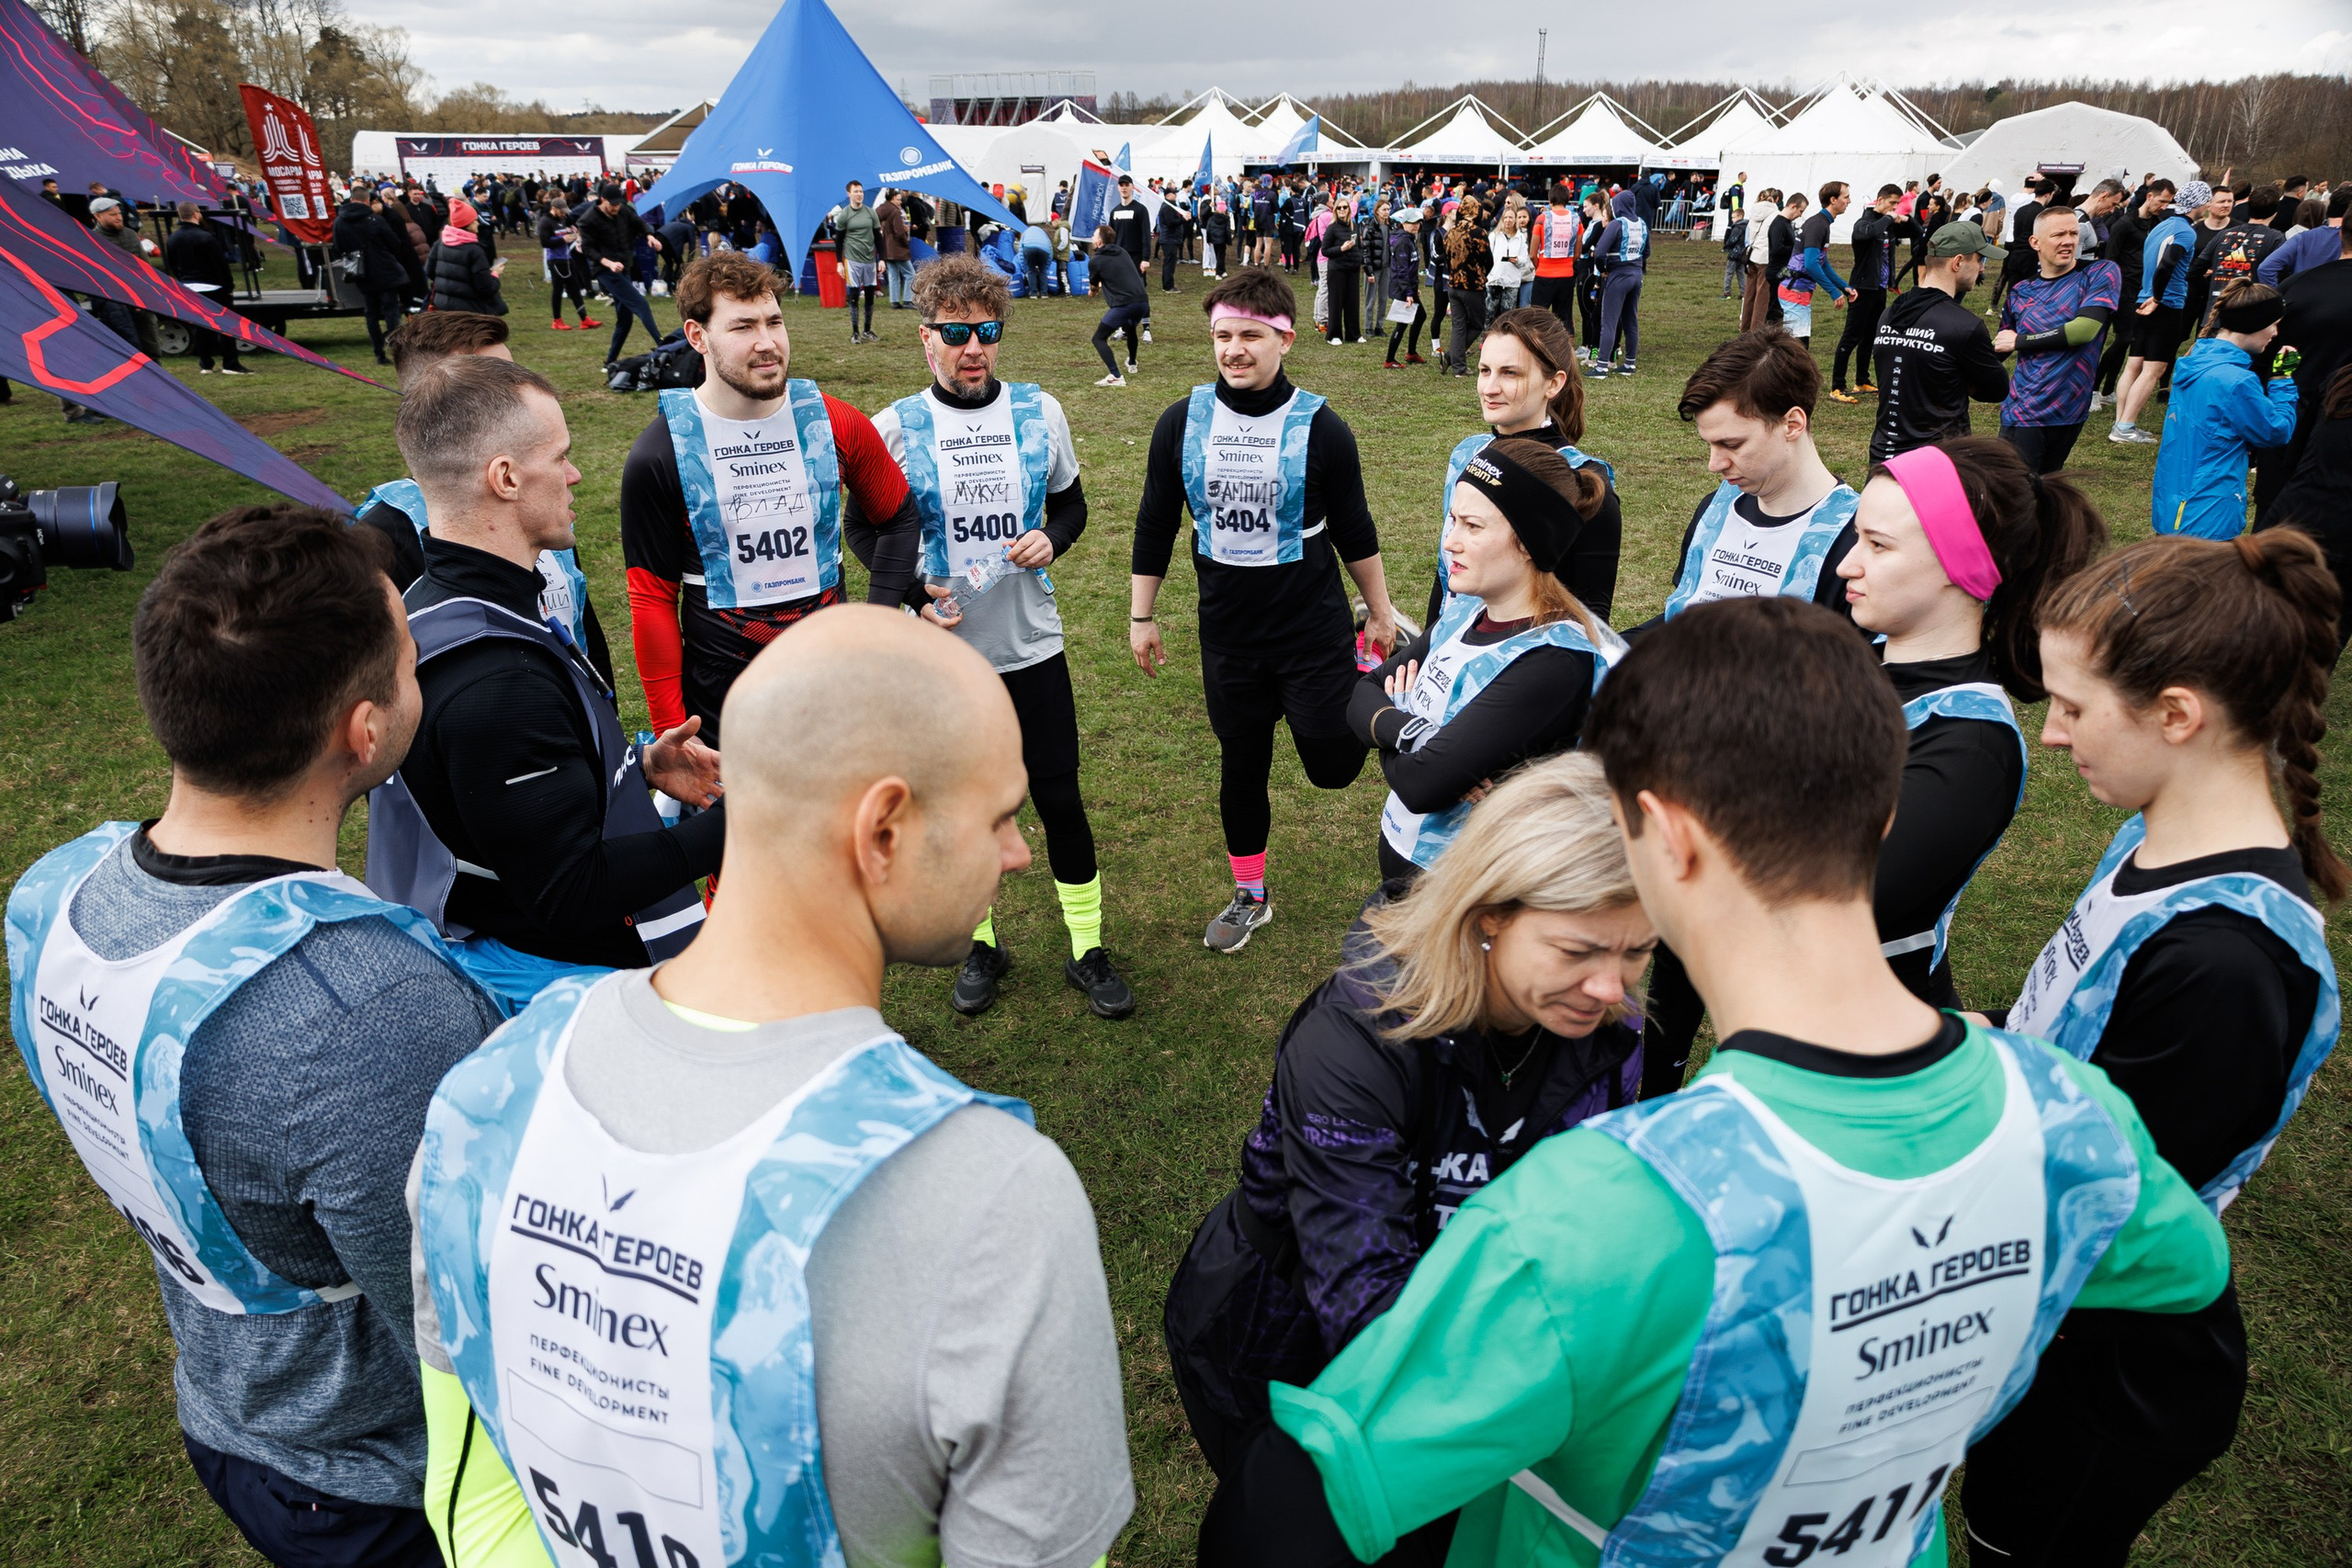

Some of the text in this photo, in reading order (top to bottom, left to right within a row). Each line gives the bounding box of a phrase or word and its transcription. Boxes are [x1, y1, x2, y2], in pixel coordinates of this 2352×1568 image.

[462, 141, 540, 151] ГОНКА ГЕРОЕВ
[0, 163, 60, 180] ДЫХА
[267, 166, 303, 177] МОСАРМ
[731, 161, 794, 174] ГОНКА ГЕРОЕВ
[878, 159, 956, 183] ГАЗПРОМБАНК
[1553, 241, 1568, 249] 5010
[1880, 324, 1936, 340] СТШИЙ
[714, 439, 795, 457] ГОНКА ГЕРОЕВ
[940, 434, 1012, 448] ГОНКА ГЕРОЕВ
[1213, 435, 1276, 446] ГОНКА ГЕРОЕВ
[952, 451, 1004, 467] Sminex
[1218, 449, 1264, 463] Sminex
[729, 461, 787, 478] Sminex
[954, 469, 1006, 479] ПЕРФЕКЦИОНИСТЫ
[733, 479, 791, 491] ПЕРФЕКЦИОНИСТЫ
[750, 486, 792, 497] DEVELOPMENT
[729, 493, 806, 524] ВЛАД
[1216, 506, 1271, 533] 5404
[953, 513, 1018, 543] 5400
[736, 525, 809, 564] 5402
[1713, 548, 1782, 574] ГОНКА ГЕРОЕВ
[764, 576, 807, 590] ГАЗПРОМБАНК
[1712, 569, 1762, 596] Sminex
[1430, 666, 1452, 689] ГЕРОЕ
[40, 994, 128, 1073] ГОНКА ГЕРОЕВ
[54, 1043, 119, 1117] Sminex
[67, 1109, 130, 1163] FINE DEVELOPMENT
[103, 1190, 206, 1286] 06
[512, 1193, 704, 1291] ГОНКА ГЕРОЕВ
[1830, 1238, 2030, 1321] ГОНКА ГЕРОЕВ
[533, 1262, 669, 1358] Sminex
[1856, 1307, 1995, 1380] Sminex
[529, 1333, 670, 1401] ПЕРФЕКЦИОНИСТЫ
[530, 1357, 670, 1425] FINE DEVELOPMENT
[1844, 1357, 1984, 1416] ПЕРФЕКЦИОНИСТЫ
[1838, 1376, 1976, 1434] FINE DEVELOPMENT
[1762, 1462, 1951, 1567] 5411
